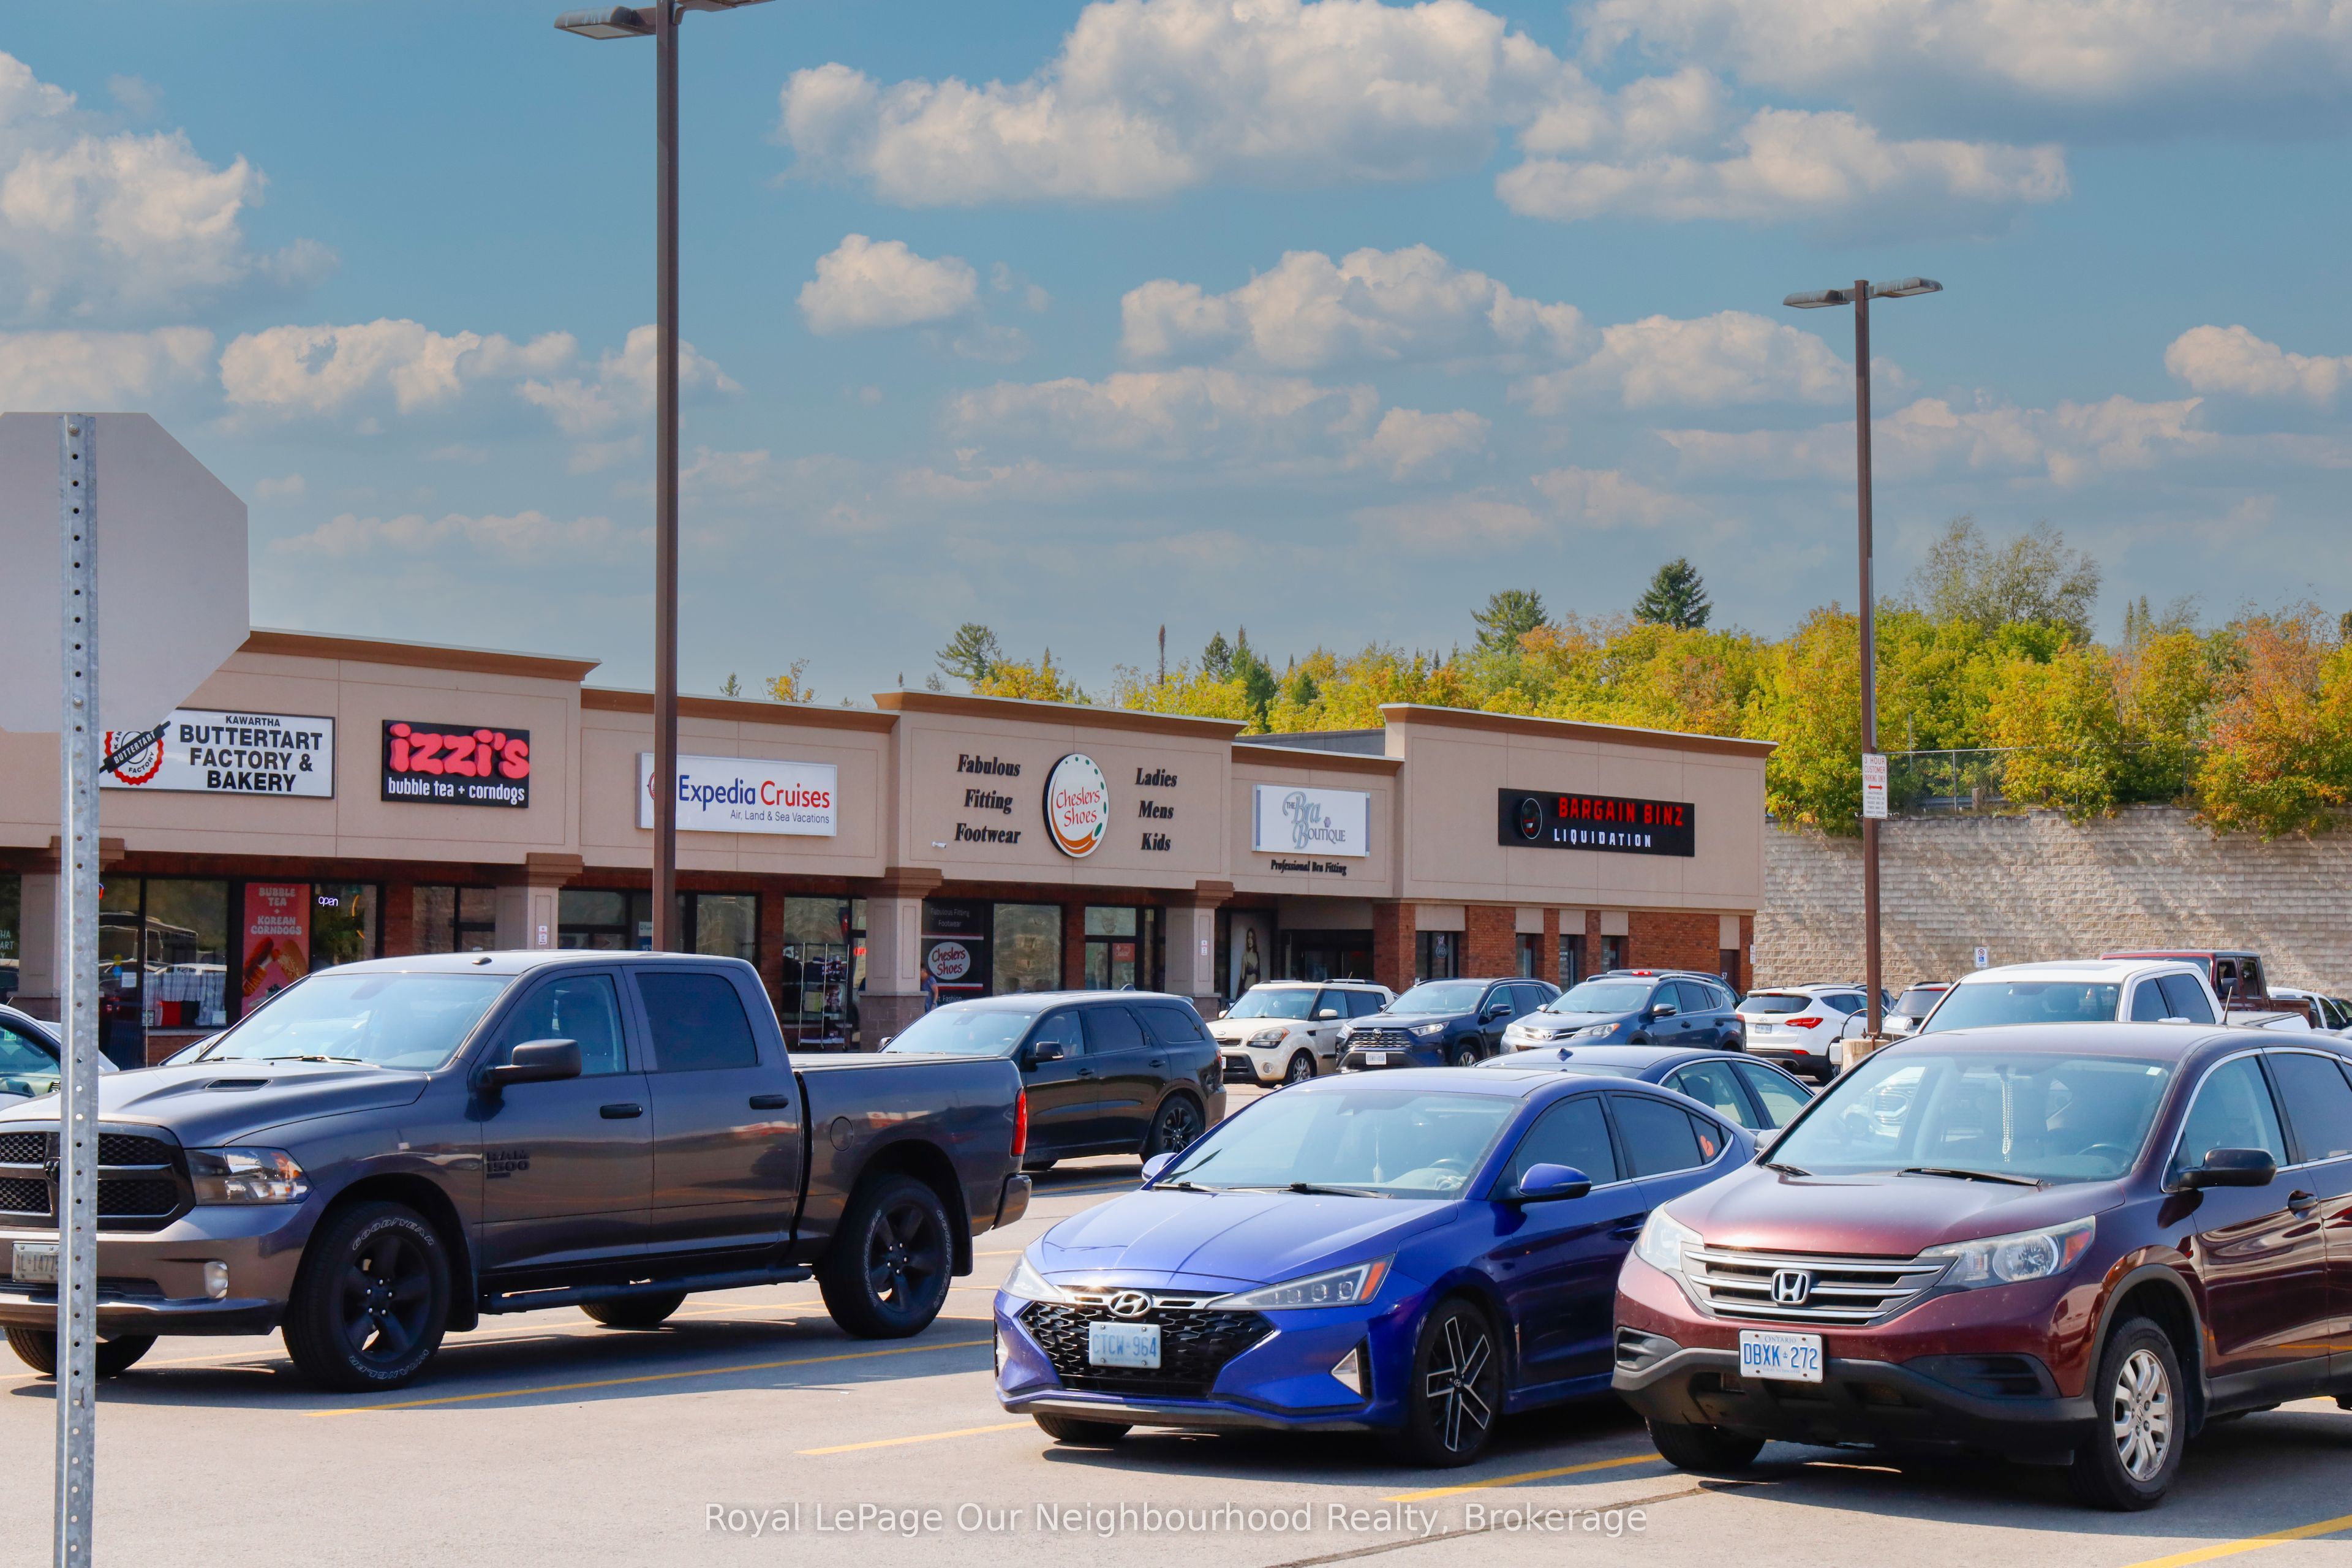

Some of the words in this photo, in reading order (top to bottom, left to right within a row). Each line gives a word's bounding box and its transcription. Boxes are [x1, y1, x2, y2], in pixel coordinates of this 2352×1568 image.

[225, 715, 281, 726] KAWARTHA
[180, 724, 323, 750] BUTTERTART
[113, 731, 156, 764] BUTTERTART
[129, 752, 154, 774] FACTORY
[190, 747, 292, 771] FACTORY
[299, 753, 313, 772] &
[957, 753, 1021, 777] Fabulous
[207, 770, 296, 792] BAKERY
[1135, 767, 1177, 787] Ladies
[388, 777, 430, 796] bubble
[434, 780, 454, 797] tea
[469, 783, 525, 805] corndogs
[679, 774, 756, 812] Expedia
[760, 780, 831, 809] Cruises
[1056, 786, 1101, 809] Cheslers
[963, 788, 1013, 815] Fitting
[1138, 800, 1174, 820] Mens
[1282, 791, 1322, 824] Bra
[1286, 801, 1296, 810] THE
[1559, 797, 1635, 823] BARGAIN
[1643, 804, 1684, 826] BINZ
[730, 809, 743, 820] Air,
[745, 810, 765, 821] Land
[767, 812, 772, 821] &
[775, 812, 790, 822] Sea
[792, 813, 829, 824] Vacations
[1064, 809, 1097, 827] Shoes
[954, 823, 1021, 844] Footwear
[1140, 832, 1171, 851] Kids
[1554, 828, 1651, 848] LIQUIDATION
[1271, 859, 1311, 873] Professional
[1312, 862, 1324, 872] Bra
[1325, 862, 1347, 876] Fitting
[258, 888, 296, 897] BUBBLE
[268, 897, 287, 907] TEA
[318, 896, 339, 907] open
[251, 925, 302, 935] CORNDOGS
[257, 915, 296, 925] KOREAN
[932, 946, 966, 962] Cheslers
[937, 961, 963, 976] Shoes
[1765, 1335, 1796, 1344] ONTARIO
